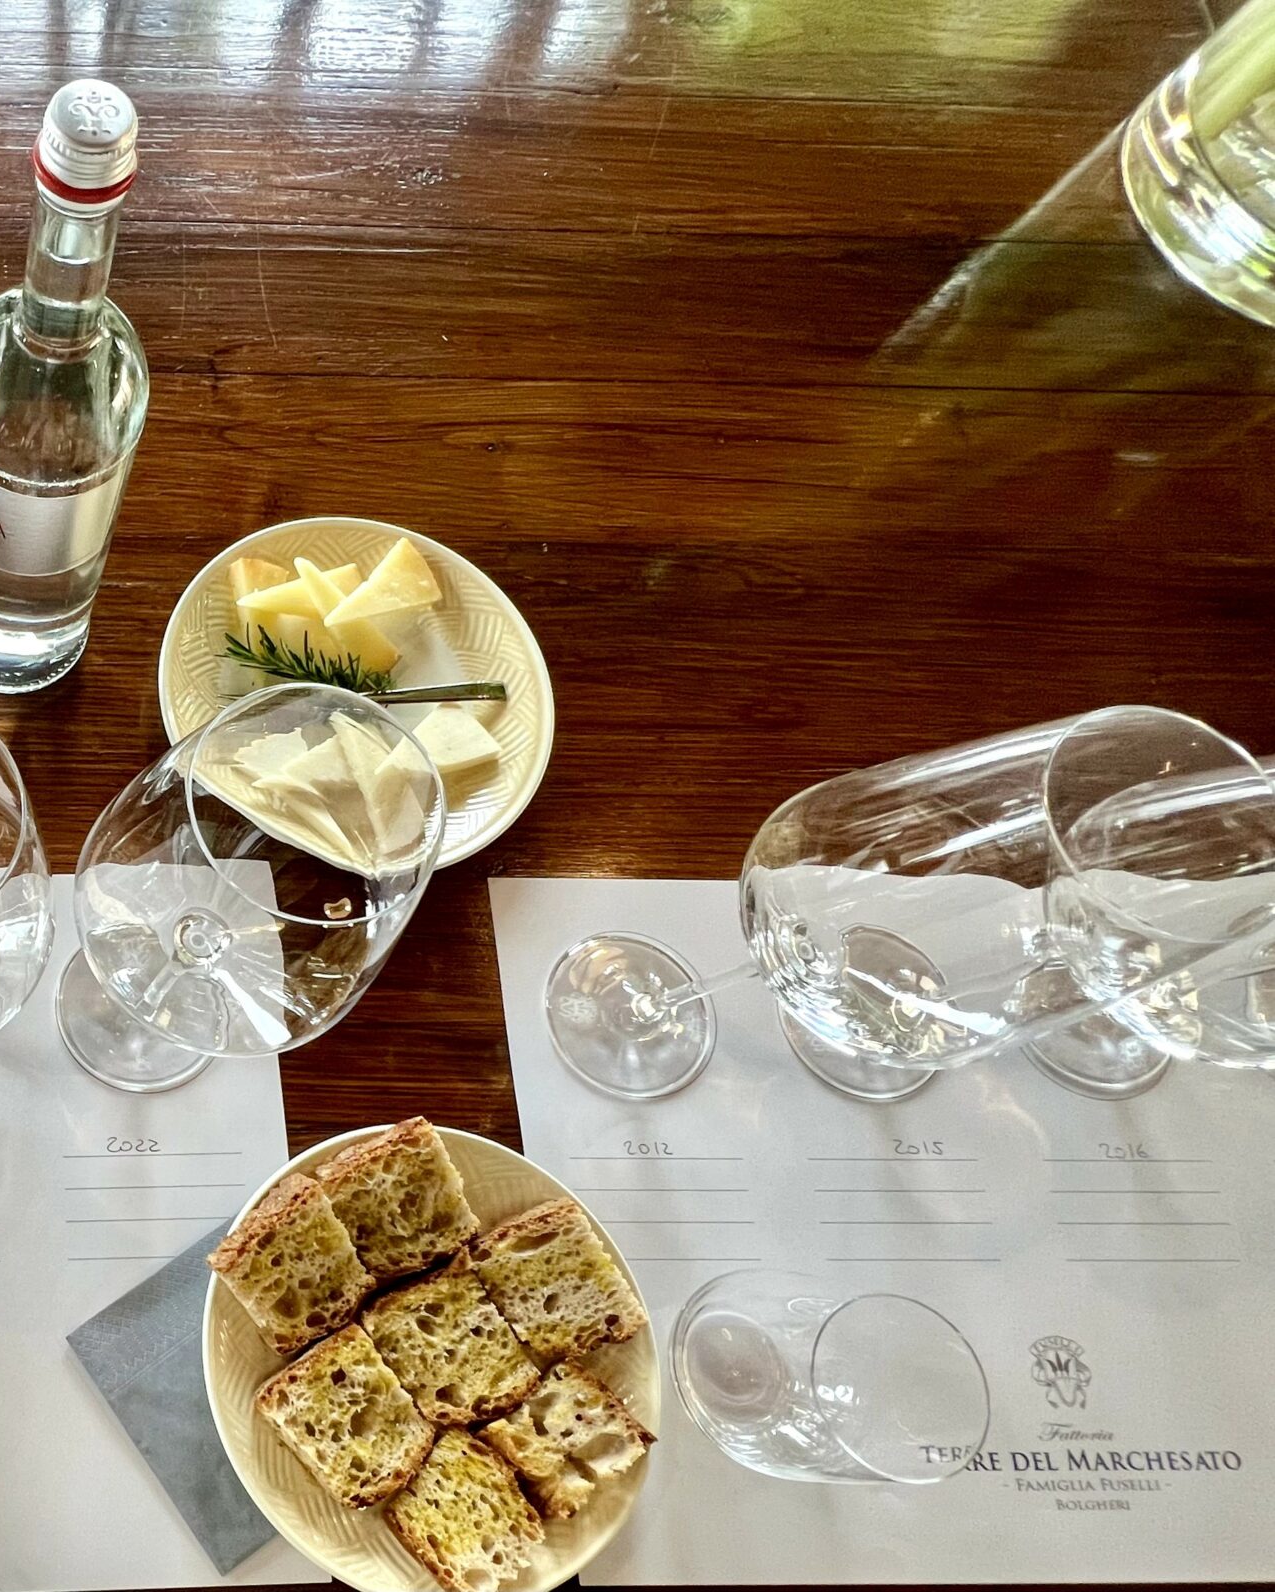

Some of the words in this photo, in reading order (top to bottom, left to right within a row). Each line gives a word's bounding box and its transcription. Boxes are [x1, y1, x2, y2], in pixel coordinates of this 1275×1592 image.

[106, 1136, 163, 1153] 2022
[623, 1140, 675, 1156] 2012
[892, 1139, 945, 1156] 2015
[1098, 1142, 1152, 1160] 2016
[1038, 1422, 1115, 1442] Fattoria
[1010, 1451, 1059, 1472] DEL
[1067, 1448, 1243, 1472] MARCHESATO
[1016, 1477, 1095, 1492] FAMIGLIA
[1101, 1477, 1162, 1492] FUSELLI
[1056, 1498, 1131, 1511] BOLGHERI
